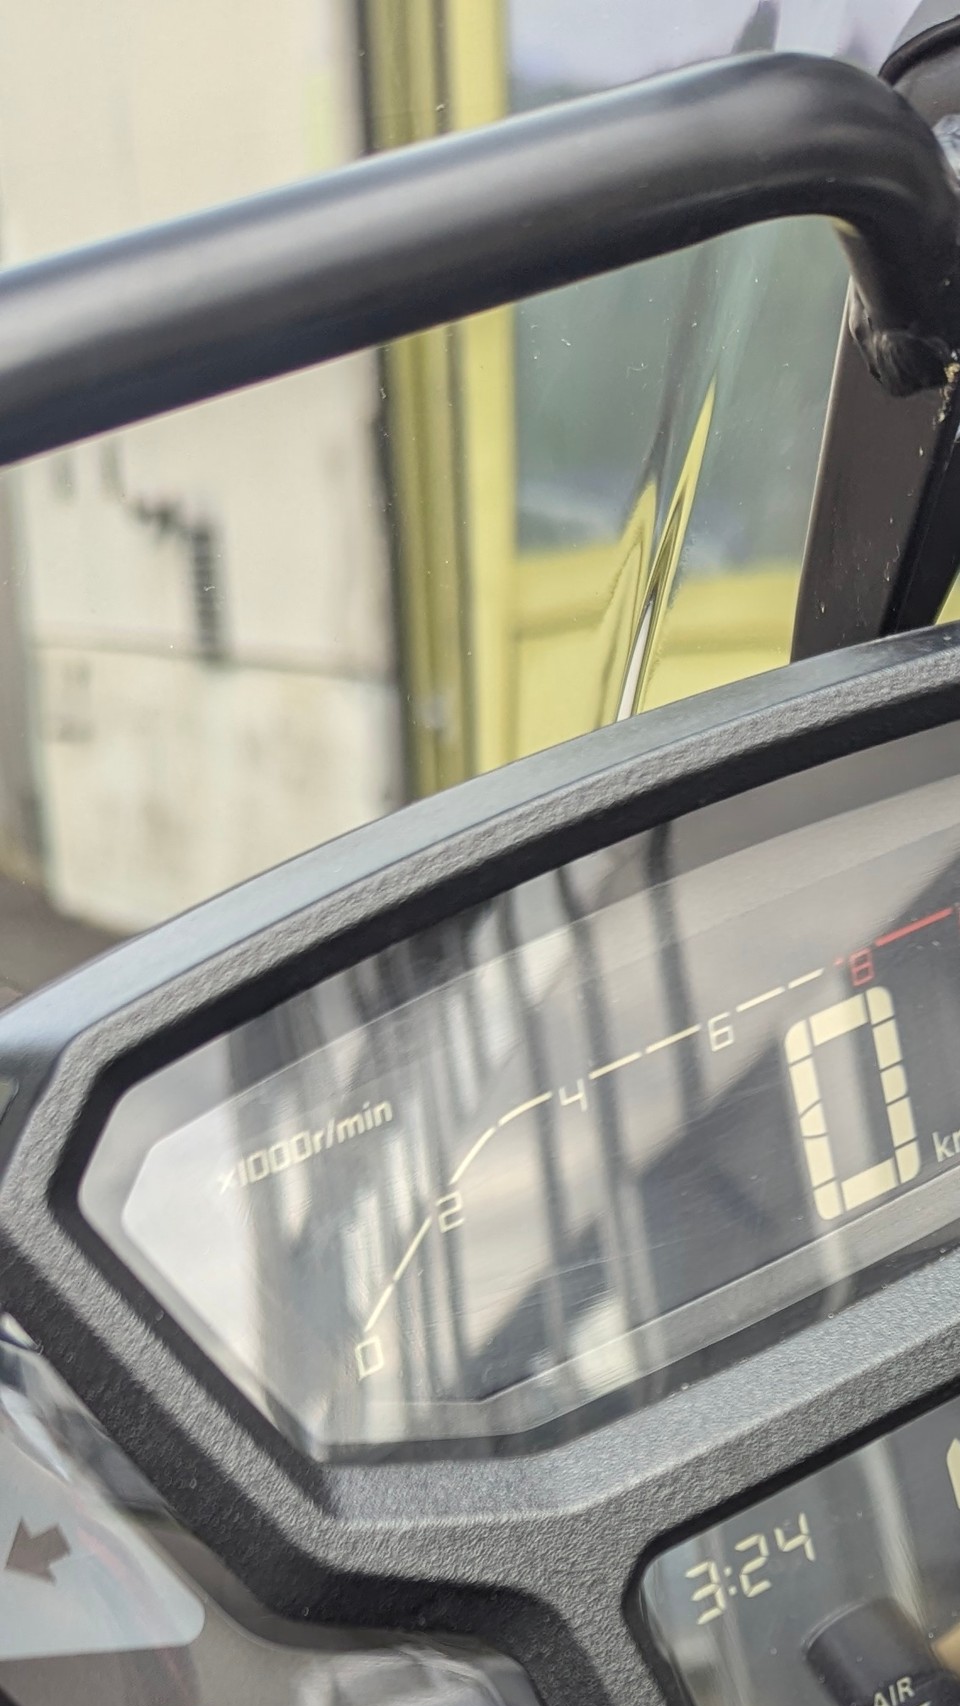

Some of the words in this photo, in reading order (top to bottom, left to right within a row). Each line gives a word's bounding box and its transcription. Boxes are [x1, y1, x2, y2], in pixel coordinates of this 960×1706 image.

[849, 948, 874, 987] 8
[707, 1012, 735, 1052] 6
[558, 1079, 588, 1112] 4
[783, 986, 921, 1221] 0
[436, 1191, 465, 1233] 2
[355, 1336, 385, 1380] 0
[684, 1512, 816, 1625] 3:24
